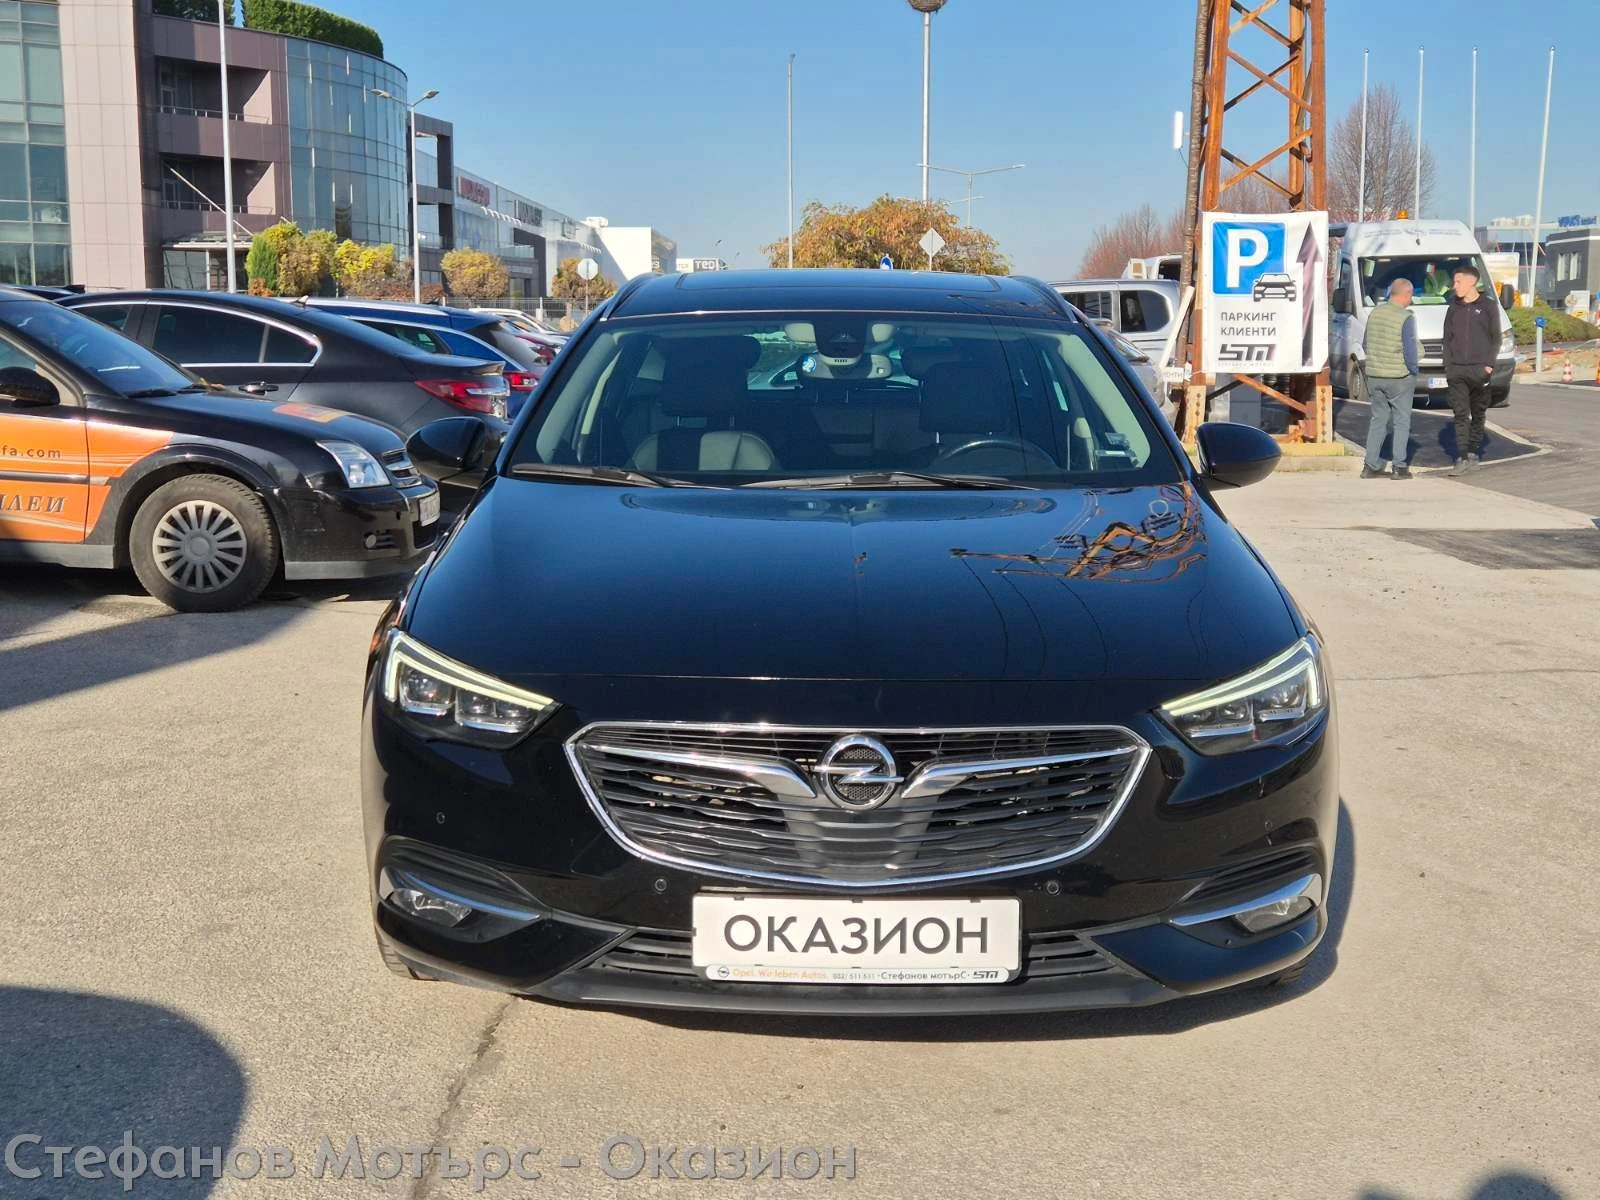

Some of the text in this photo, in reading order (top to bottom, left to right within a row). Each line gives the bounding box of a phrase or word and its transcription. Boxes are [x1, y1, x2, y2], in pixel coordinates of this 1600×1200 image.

[1226, 229, 1269, 288] P
[1220, 311, 1277, 321] ПАРКИНГ
[1220, 327, 1277, 337] КЛИЕНТИ
[724, 914, 988, 954] ОКАЗИОН
